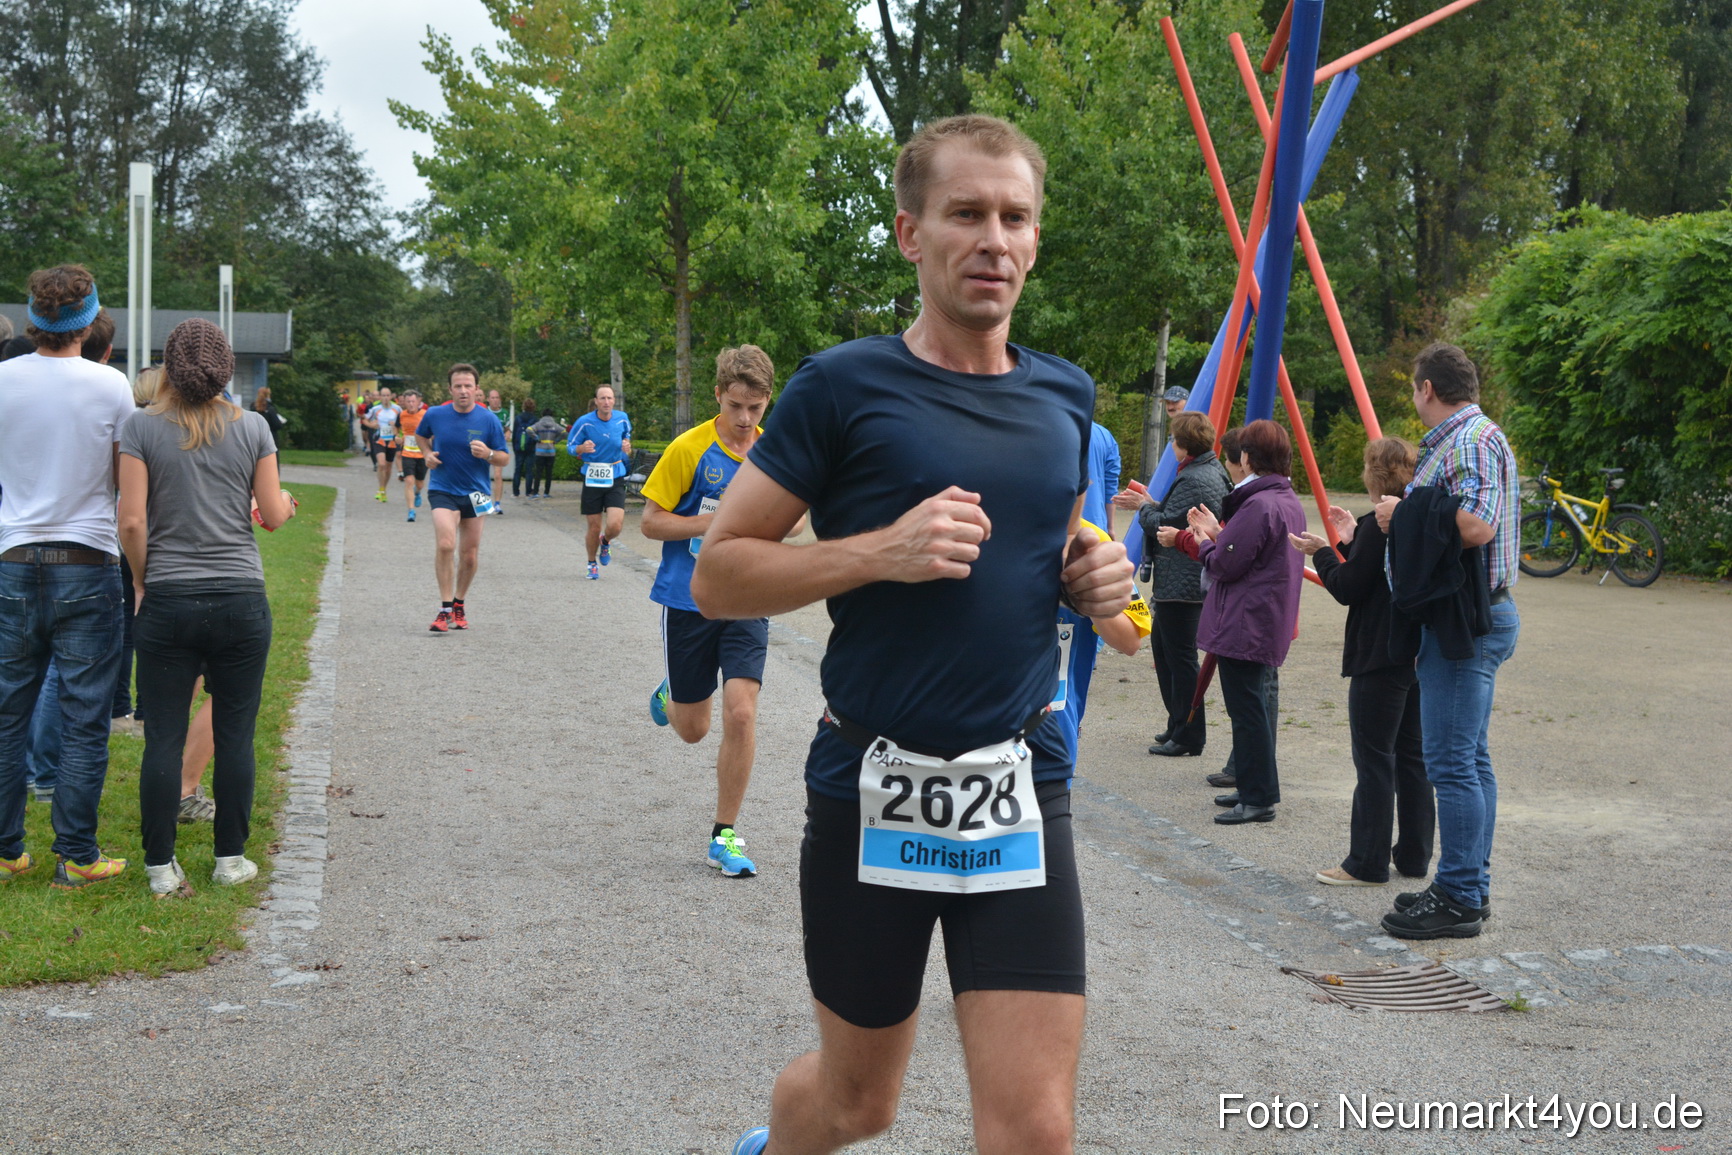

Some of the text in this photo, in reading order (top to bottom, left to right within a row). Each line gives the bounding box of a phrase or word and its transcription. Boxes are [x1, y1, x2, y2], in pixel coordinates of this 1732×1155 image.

[588, 468, 611, 478] 2462
[881, 770, 1022, 831] 2628
[869, 816, 876, 826] B
[900, 840, 1001, 870] Christian
